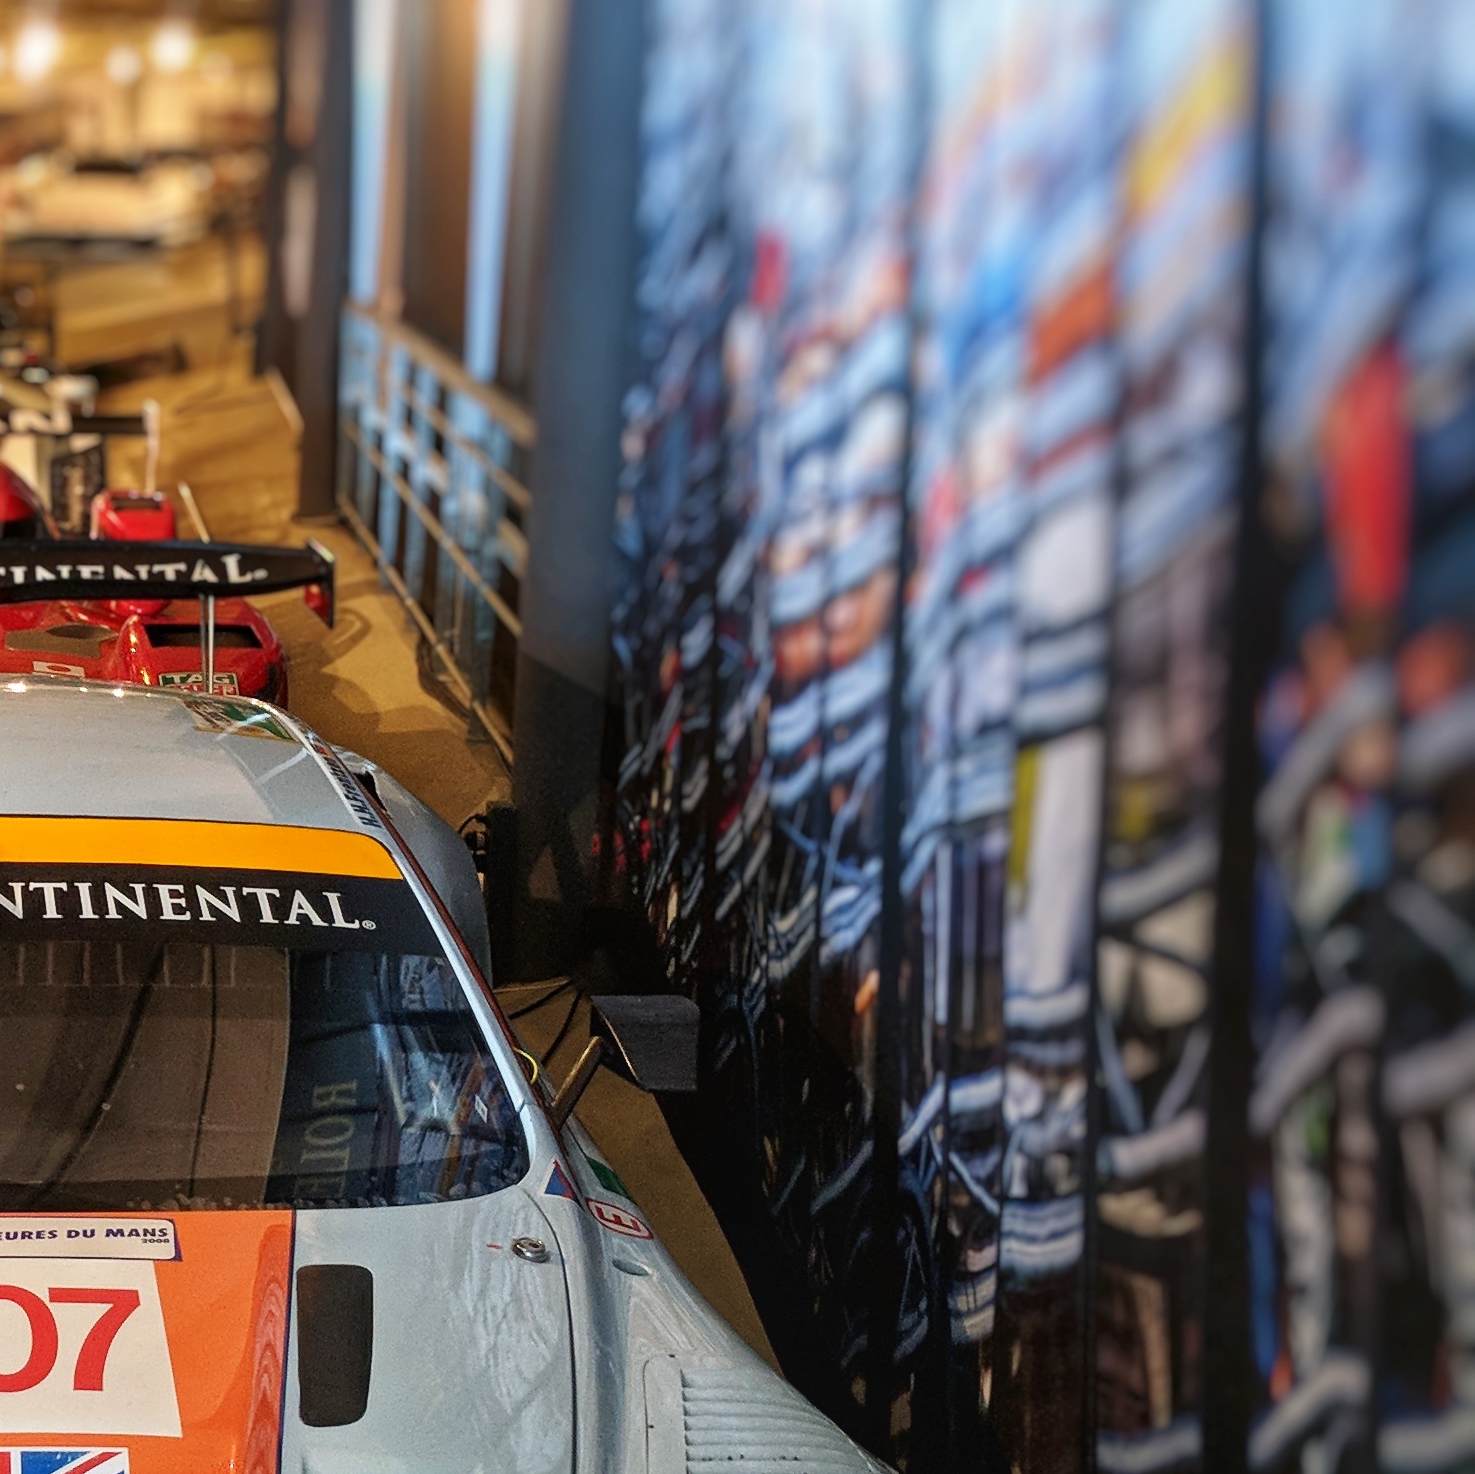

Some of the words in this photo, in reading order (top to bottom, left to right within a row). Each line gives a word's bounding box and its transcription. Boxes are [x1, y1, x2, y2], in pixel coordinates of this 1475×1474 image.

[595, 1205, 642, 1232] E
[66, 1228, 96, 1239] DU
[105, 1227, 169, 1239] MANS
